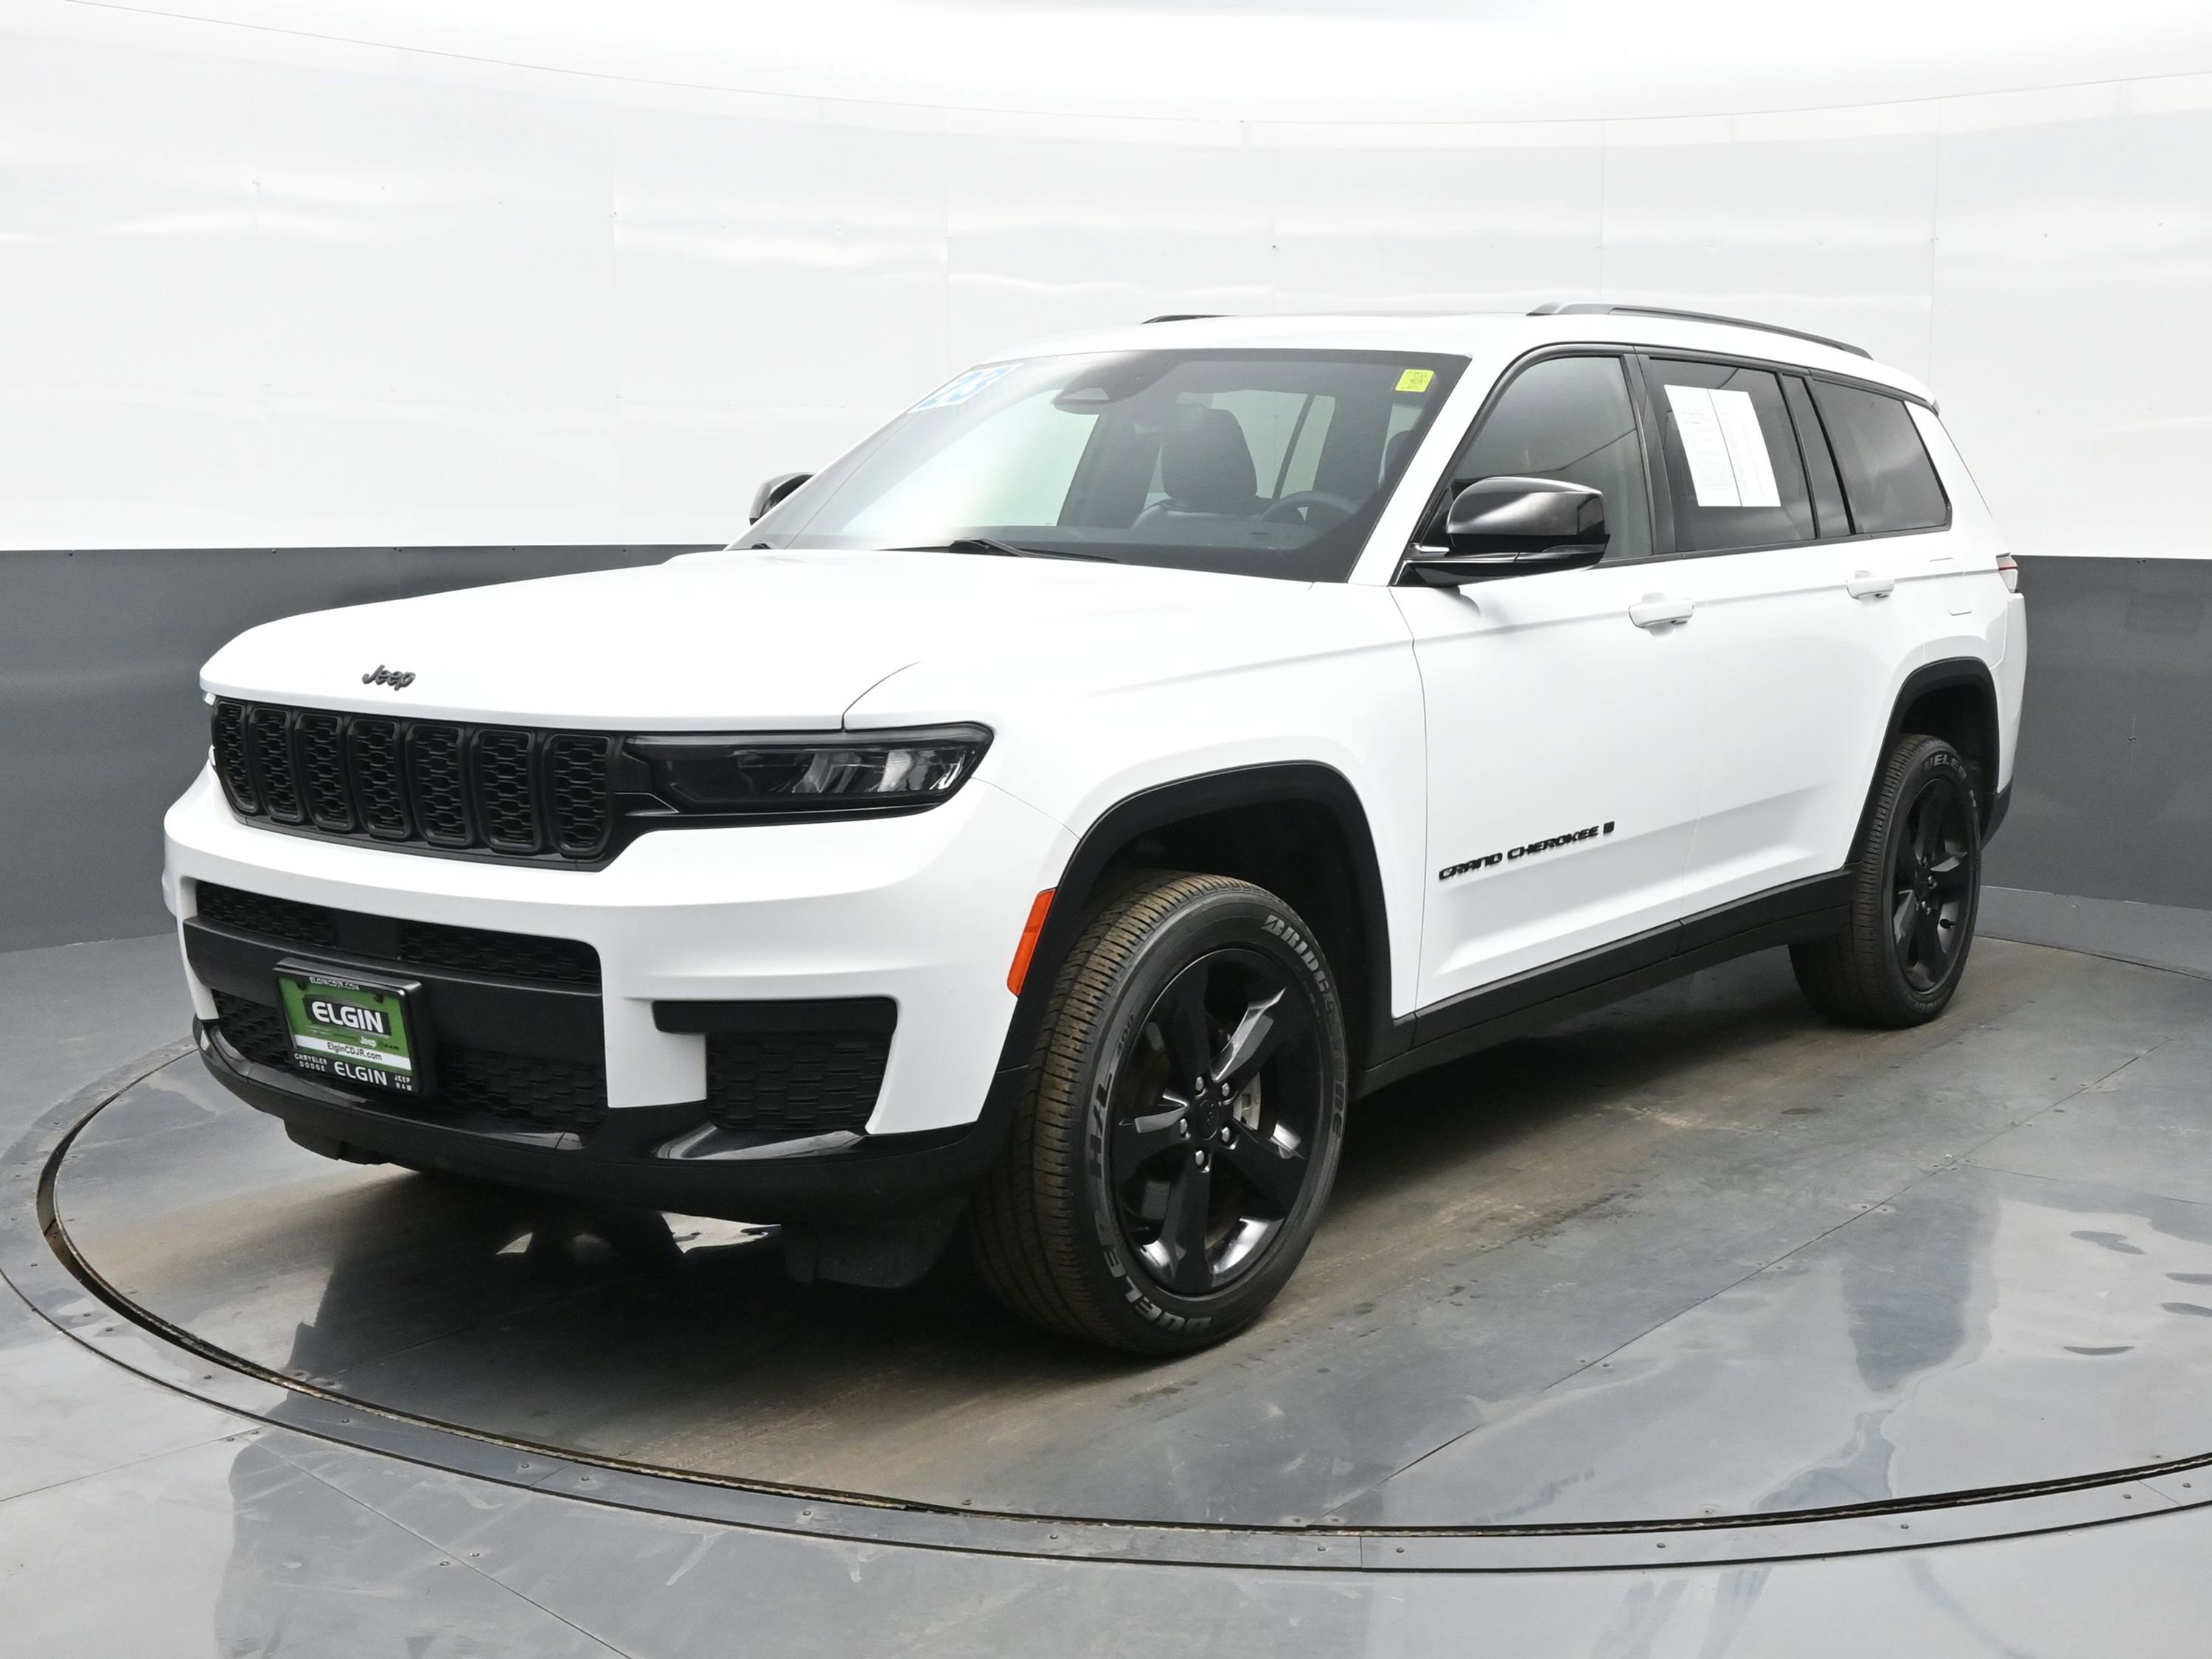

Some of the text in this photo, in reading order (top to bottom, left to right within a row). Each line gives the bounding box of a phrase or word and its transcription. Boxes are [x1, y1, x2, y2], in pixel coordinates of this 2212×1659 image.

[361, 664, 416, 691] Jeep
[1439, 852, 1503, 880] GRAND
[1507, 825, 1599, 860] CHEROKEE
[311, 1001, 384, 1034] ELGIN
[1260, 914, 1346, 1140] BRIDGEONE
[327, 1041, 383, 1062] ElginCDJR.com
[360, 1035, 378, 1048] Jeep
[294, 1052, 328, 1065] CHRYSLER
[299, 1061, 326, 1072] DODGE
[334, 1061, 388, 1086] ELGIN
[394, 1074, 411, 1084] JEEP
[395, 1082, 412, 1091] RAM
